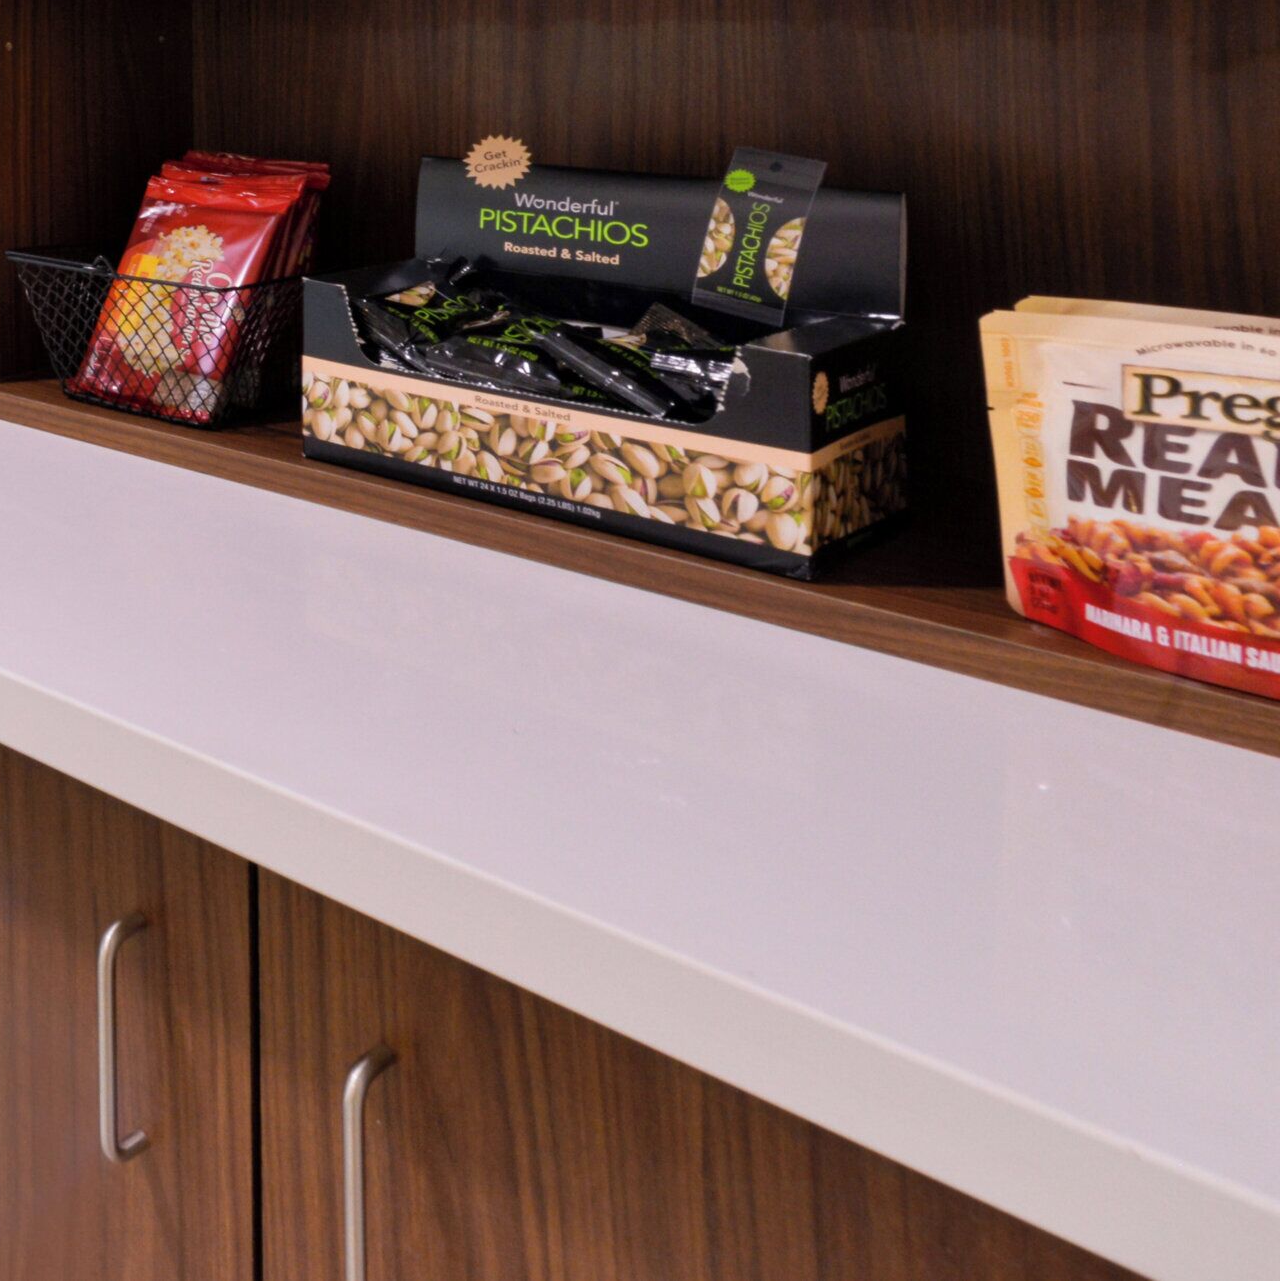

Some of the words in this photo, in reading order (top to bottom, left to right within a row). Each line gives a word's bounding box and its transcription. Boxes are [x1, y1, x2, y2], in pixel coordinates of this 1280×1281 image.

[484, 150, 507, 161] Get
[514, 192, 615, 217] Wonderful
[747, 190, 785, 204] Wonderful
[479, 208, 649, 248] PISTACHIOS
[503, 241, 557, 258] Roasted
[561, 248, 571, 260] &
[575, 250, 620, 265] Salted
[733, 202, 772, 288] PISTACHIOS
[466, 335, 486, 347] NET
[487, 339, 497, 349] WT
[1135, 339, 1236, 356] Microwavable
[1242, 341, 1255, 351] in
[475, 395, 519, 412] Roasted
[522, 404, 531, 414] &
[534, 407, 571, 422] Salted
[1131, 372, 1280, 444] Preg
[1069, 399, 1280, 490] REA
[453, 475, 466, 485] NET
[468, 479, 478, 488] WT
[480, 482, 489, 490] 24
[497, 487, 507, 495] 1.5
[508, 489, 518, 498] OZ
[520, 492, 536, 503] Bags
[538, 496, 556, 507] (2.25
[557, 501, 574, 512] LBS)
[1066, 459, 1280, 532] MEA
[1085, 602, 1153, 644] MARINARA
[1156, 625, 1170, 647] &
[1173, 629, 1243, 665] ITALIAN
